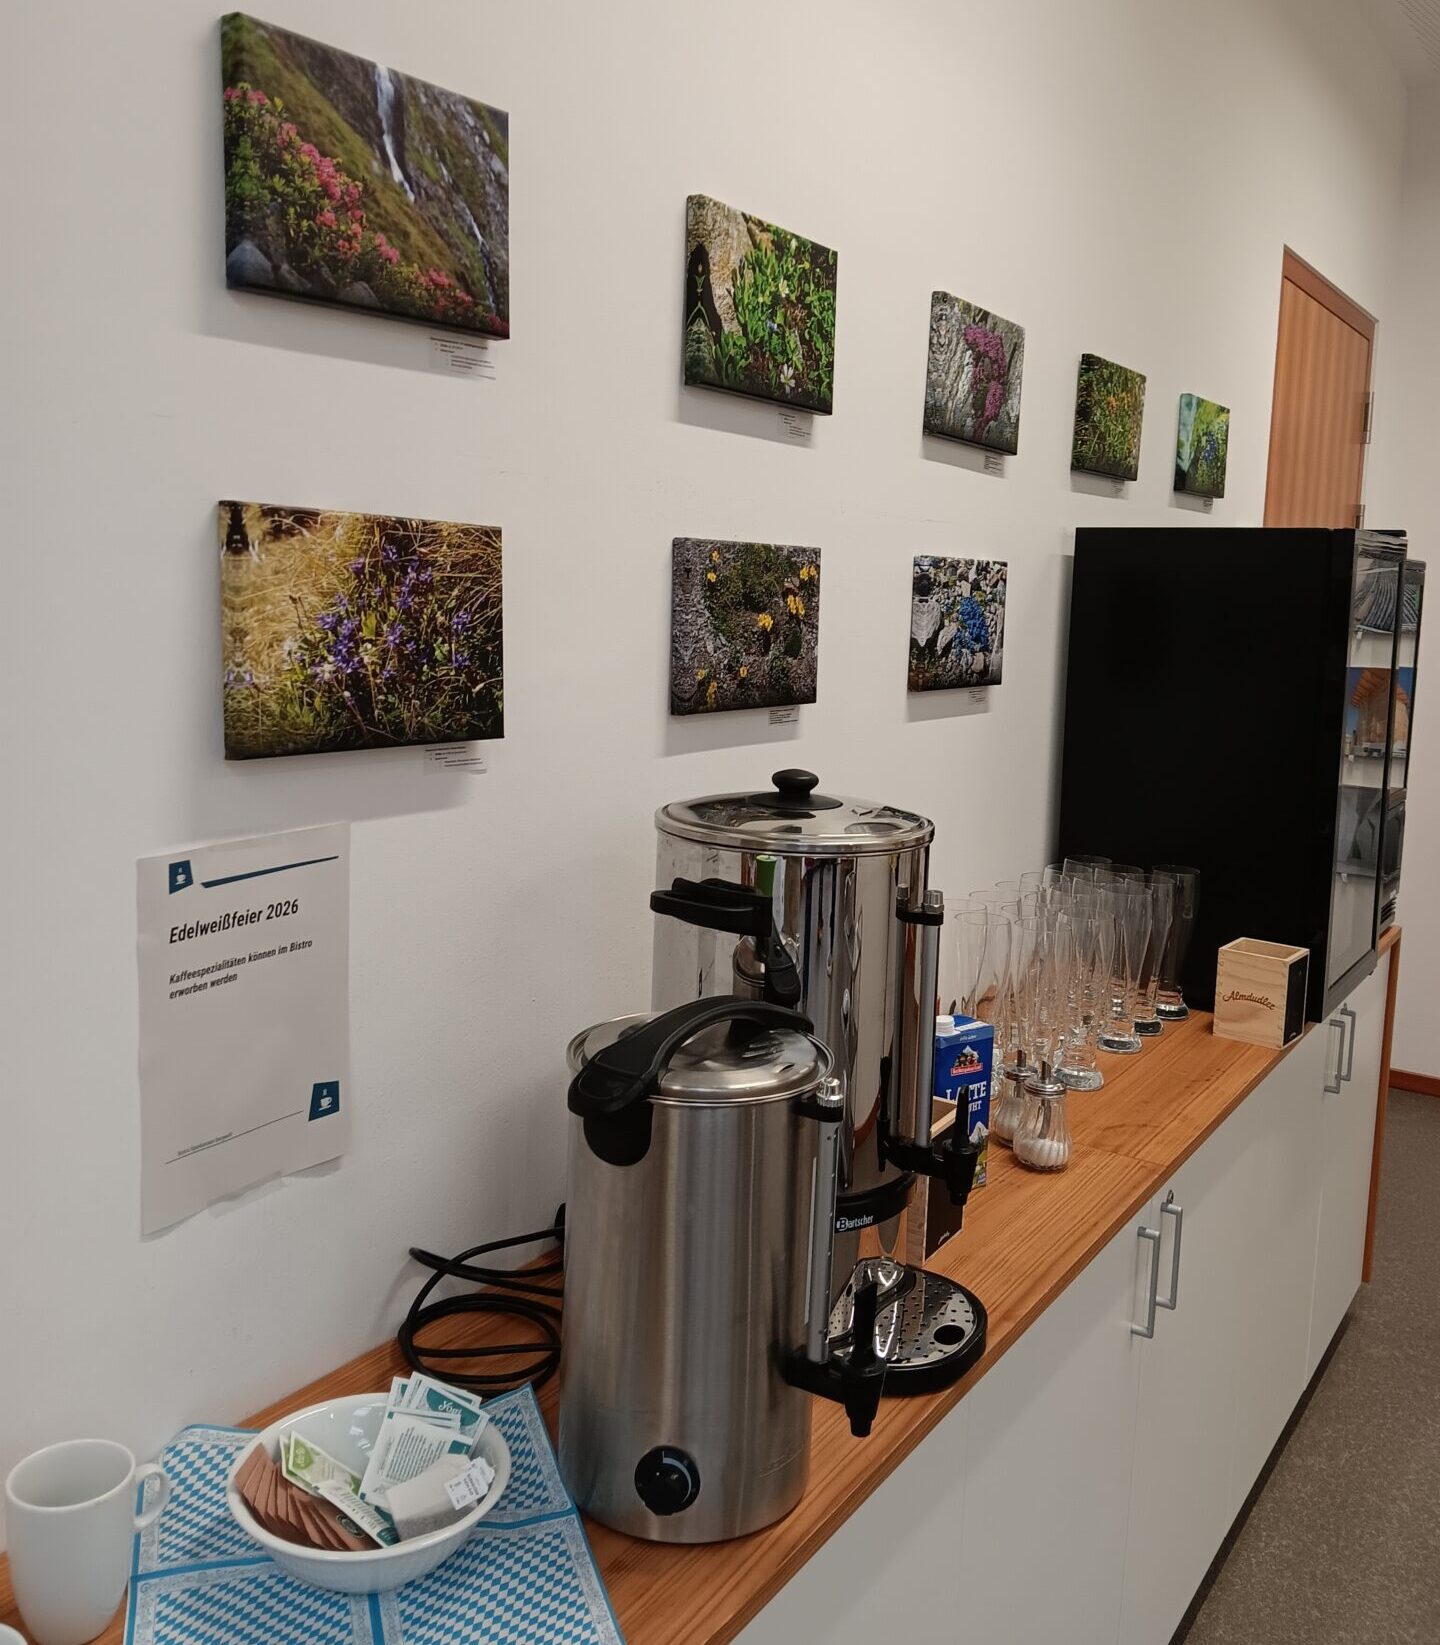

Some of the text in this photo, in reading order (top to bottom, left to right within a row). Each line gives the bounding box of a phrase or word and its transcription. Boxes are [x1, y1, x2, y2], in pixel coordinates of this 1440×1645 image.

[169, 899, 299, 944] Edelweißfeier 2026
[169, 939, 313, 985] Kaffeespezialitäten können im Bistro
[169, 972, 238, 999] erworben werden
[836, 1215, 874, 1232] Bartscher
